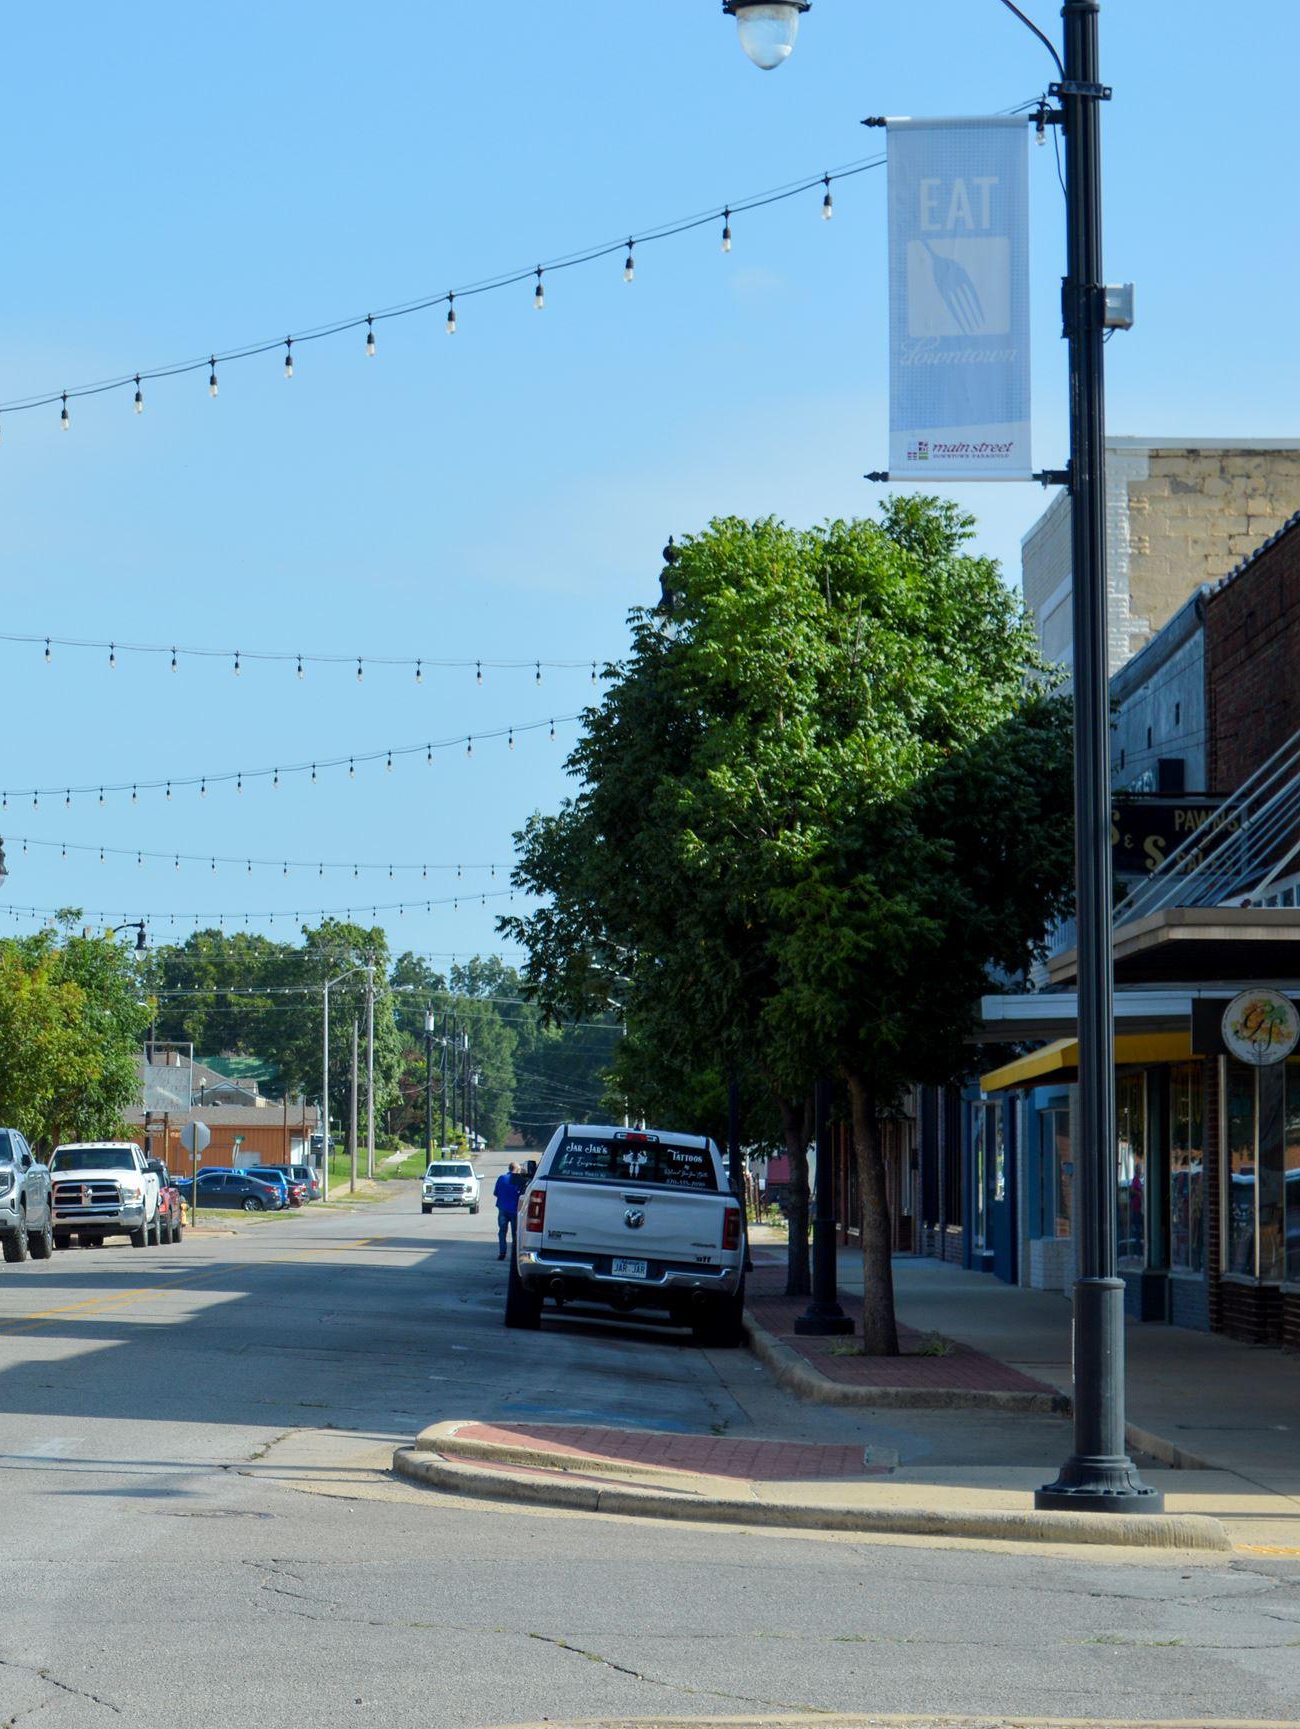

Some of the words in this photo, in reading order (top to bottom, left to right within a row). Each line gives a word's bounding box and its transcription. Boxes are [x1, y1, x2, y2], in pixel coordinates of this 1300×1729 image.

[920, 177, 999, 231] EAT
[900, 336, 1018, 366] Downtown
[932, 442, 970, 453] main
[971, 441, 1014, 453] street
[1174, 809, 1239, 831] PAWNS
[565, 1142, 583, 1152] JAR
[667, 1149, 703, 1163] TATTOOS
[614, 1262, 628, 1273] JAR
[632, 1263, 646, 1274] JAR
